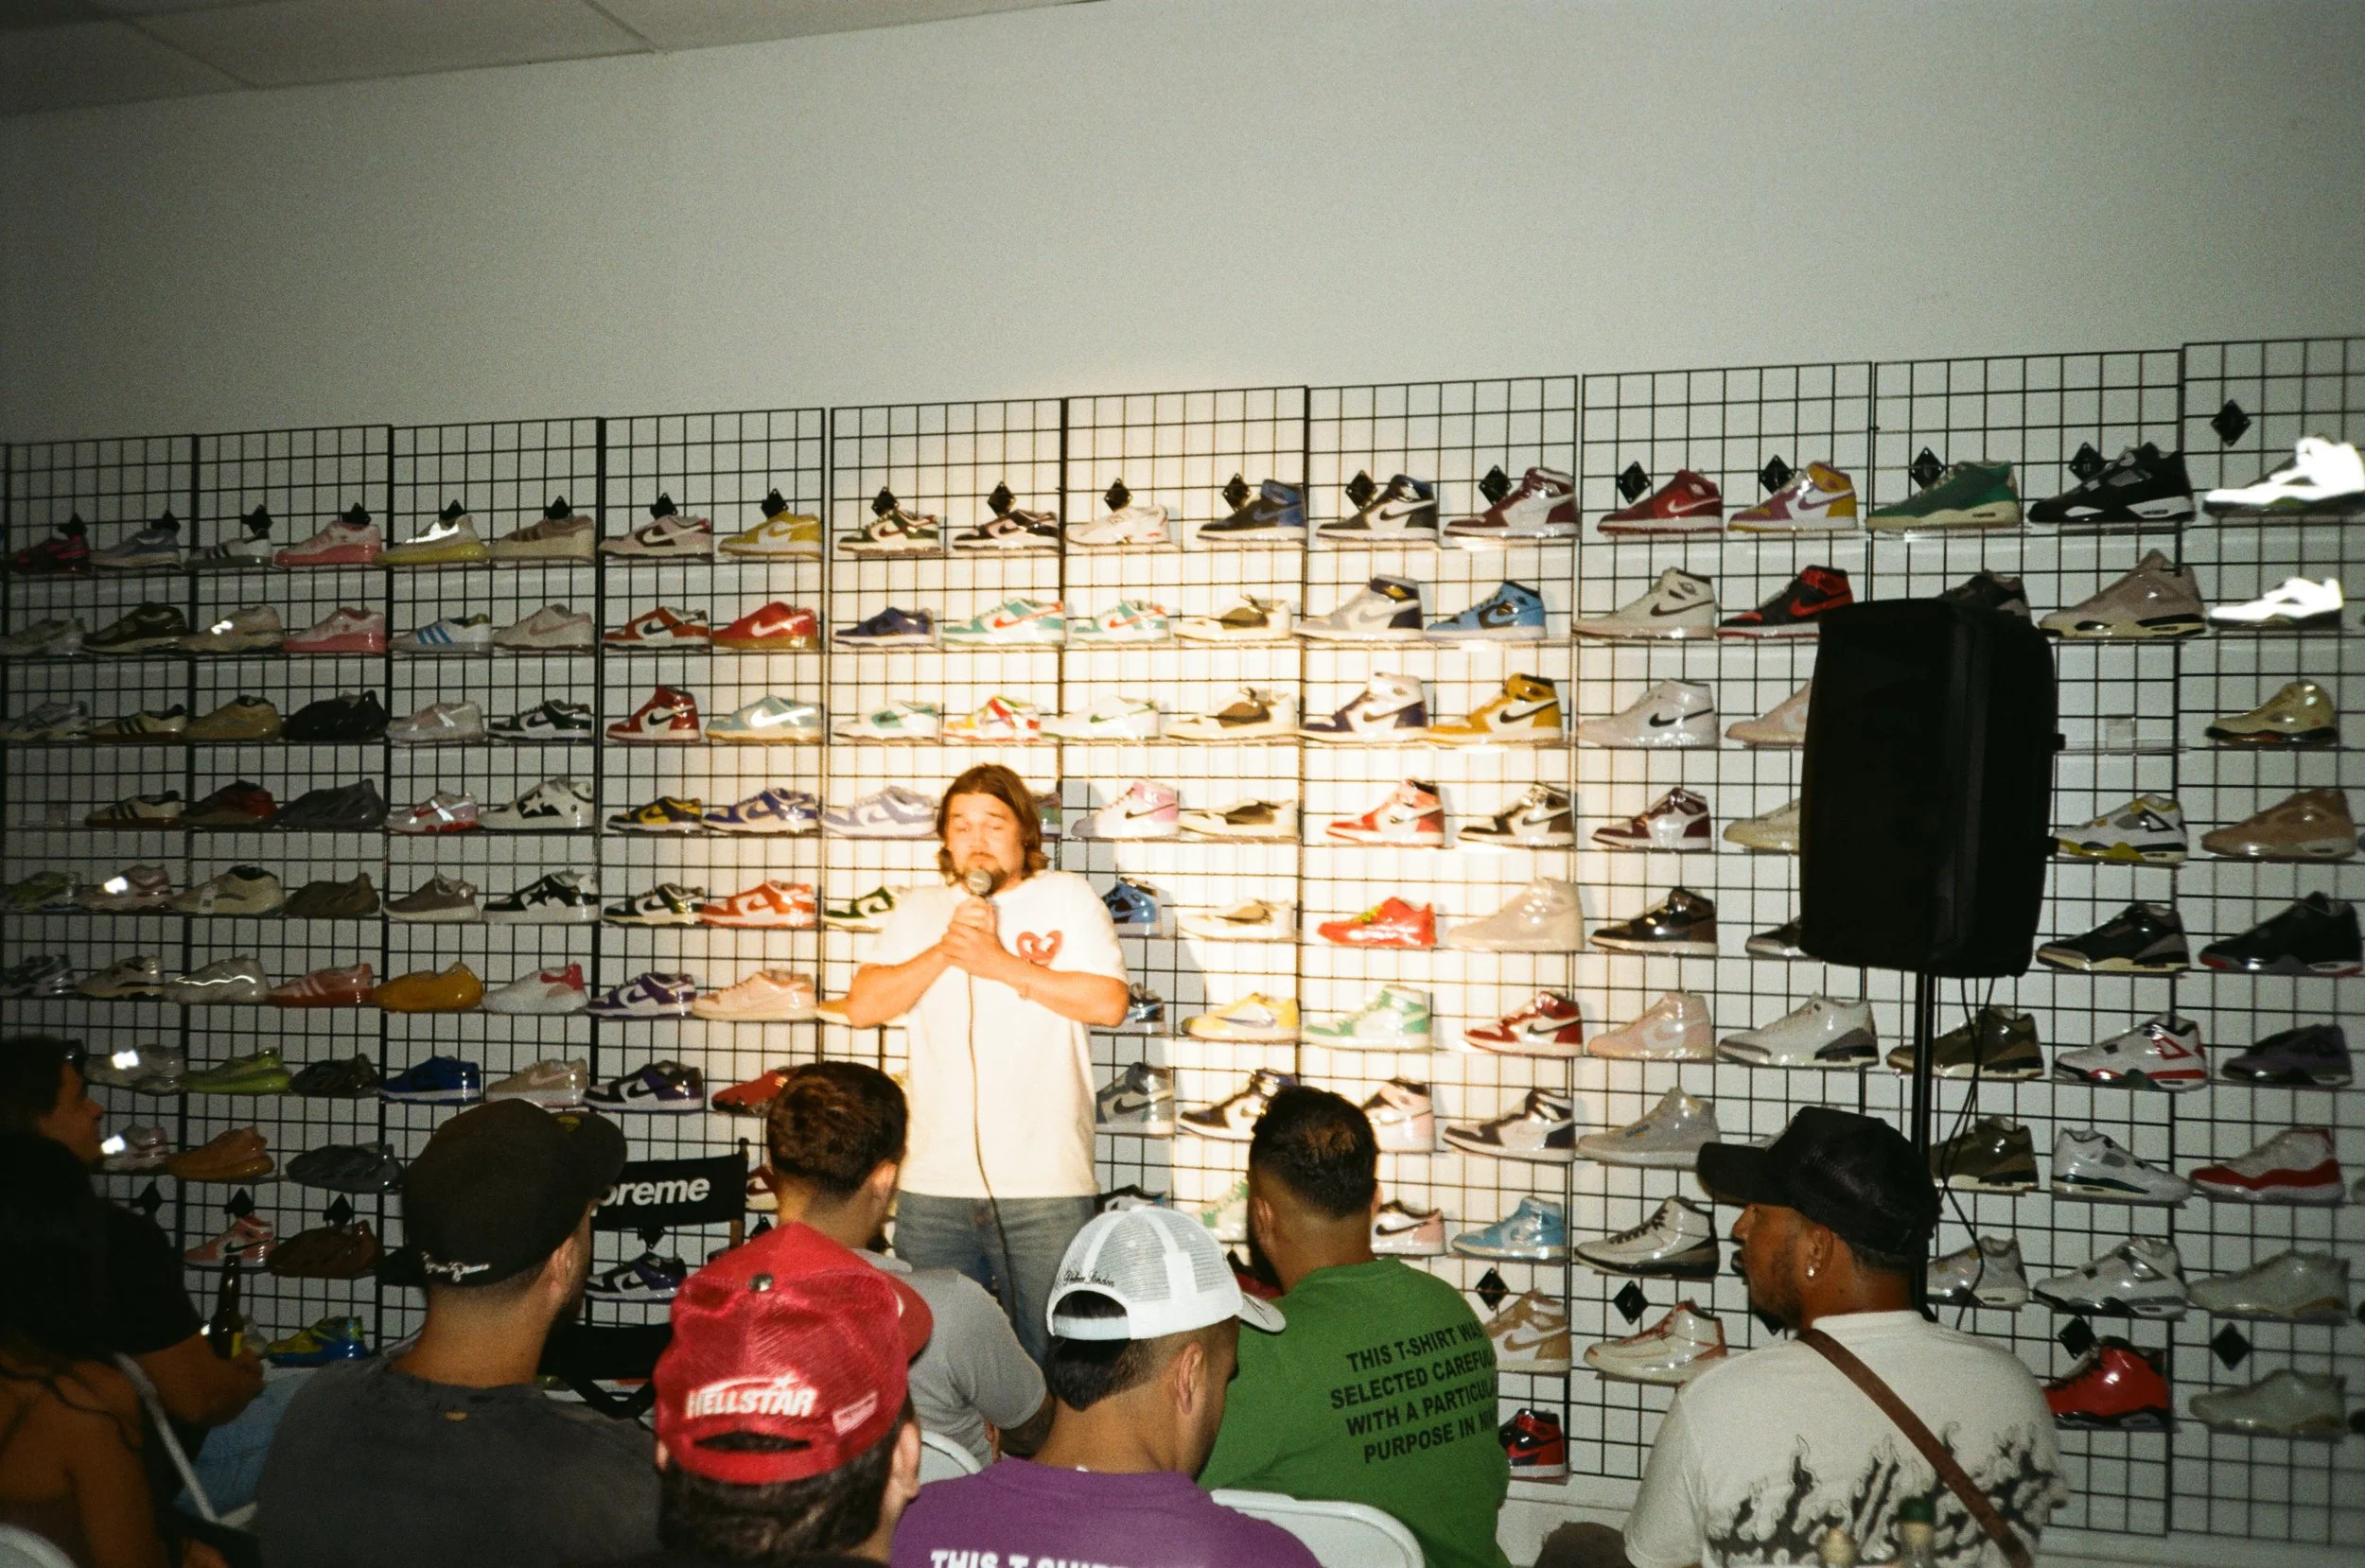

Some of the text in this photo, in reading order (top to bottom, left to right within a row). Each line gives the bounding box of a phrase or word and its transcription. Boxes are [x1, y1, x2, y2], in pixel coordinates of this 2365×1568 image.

[1346, 1345, 1393, 1372] THIS
[1394, 1327, 1458, 1360] T-SHIRT
[686, 1385, 817, 1420] HELLSTAR
[1330, 1368, 1428, 1409] SELECTED
[1346, 1406, 1400, 1437] WITH
[1407, 1402, 1419, 1422] A
[1364, 1422, 1455, 1464] PURPOSE
[1459, 1414, 1476, 1438] IN
